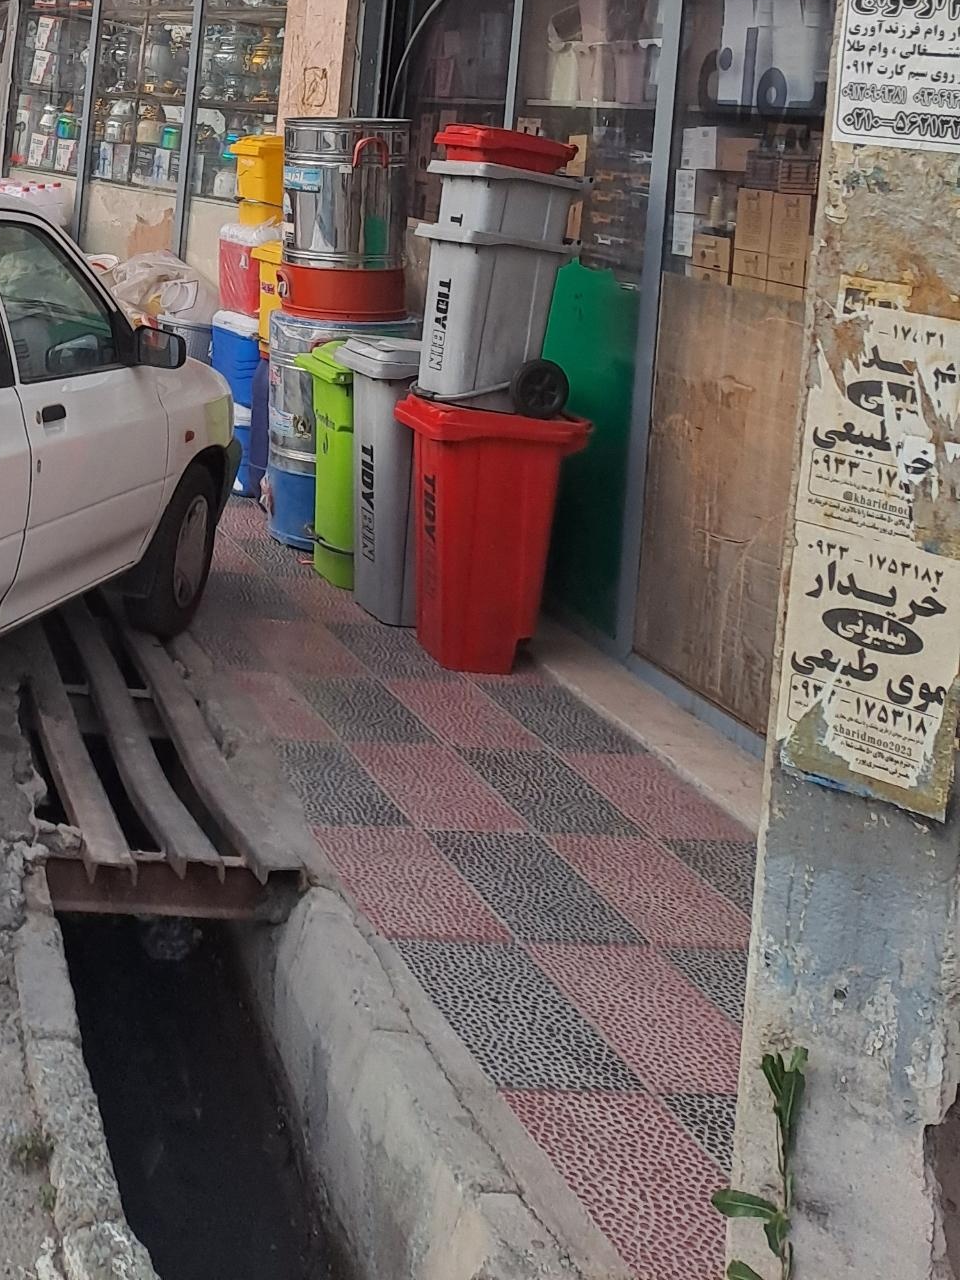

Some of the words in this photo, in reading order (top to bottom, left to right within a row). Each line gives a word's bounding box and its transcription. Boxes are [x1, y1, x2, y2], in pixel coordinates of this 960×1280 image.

[848, 20, 921, 40] فرزندآوری
[923, 24, 945, 41] وام
[846, 39, 866, 52] طلا
[868, 42, 888, 58] وام
[846, 60, 874, 75] ۰۹۱۲
[877, 64, 907, 80] کارت
[907, 70, 929, 81] سیم
[930, 70, 955, 83] روی
[361, 444, 375, 563] TIDYBIN
[805, 561, 948, 624] خریدار
[837, 610, 908, 648] میلیونی
[791, 649, 879, 687] طبیعی
[887, 674, 947, 712] موی
